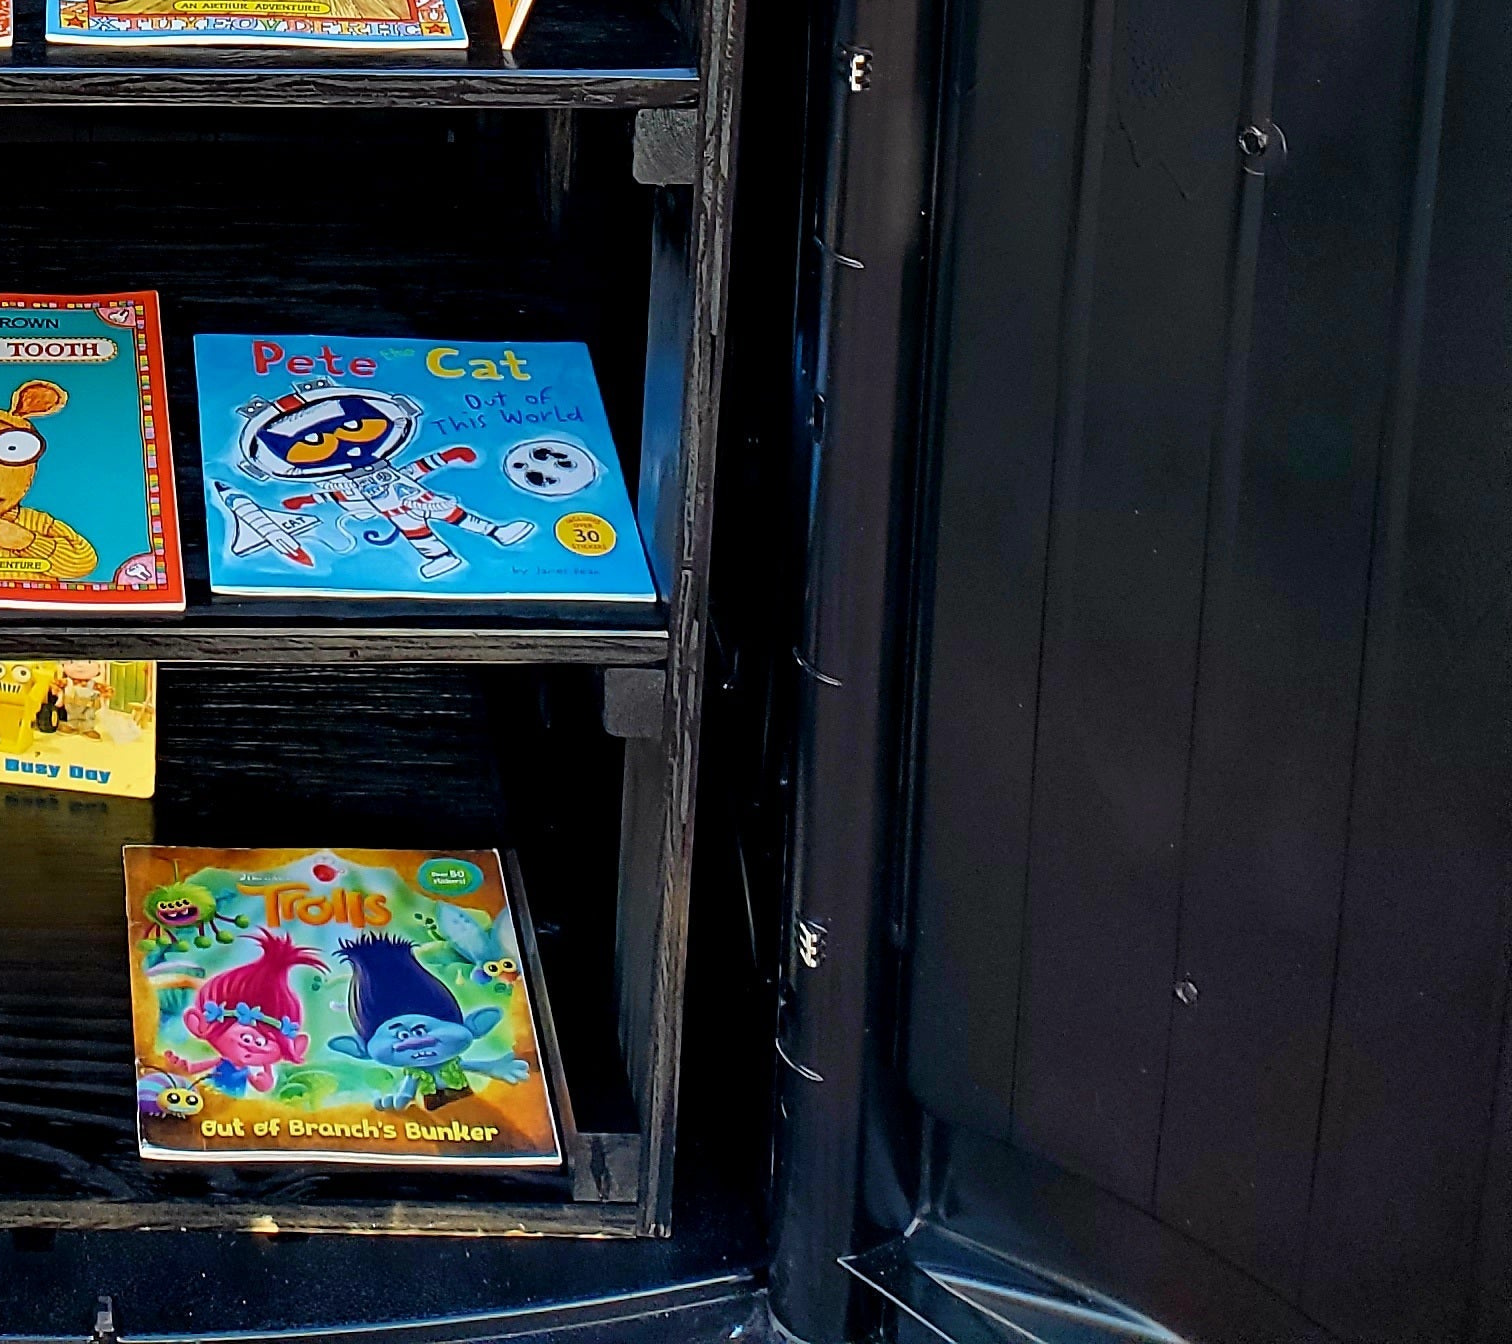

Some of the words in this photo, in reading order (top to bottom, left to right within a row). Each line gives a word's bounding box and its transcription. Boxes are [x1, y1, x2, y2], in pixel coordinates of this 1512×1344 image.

[181, 2, 197, 10] AN
[202, 2, 249, 11] ARTHUR
[253, 3, 321, 12] ADVENTURE
[5, 342, 101, 358] TOOTH
[252, 340, 378, 378] Pete
[426, 347, 532, 381] Cat
[464, 392, 508, 410] Out
[525, 386, 553, 406] of
[431, 413, 488, 436] This
[499, 406, 584, 425] World
[282, 517, 306, 529] CAT
[573, 528, 600, 543] 30
[5, 758, 61, 779] Busy
[69, 765, 111, 784] Day
[236, 883, 392, 928] Trolls
[200, 1119, 245, 1138] Out
[254, 1118, 281, 1137] of
[290, 1118, 397, 1140] Branch's
[405, 1121, 499, 1143] Bunker
